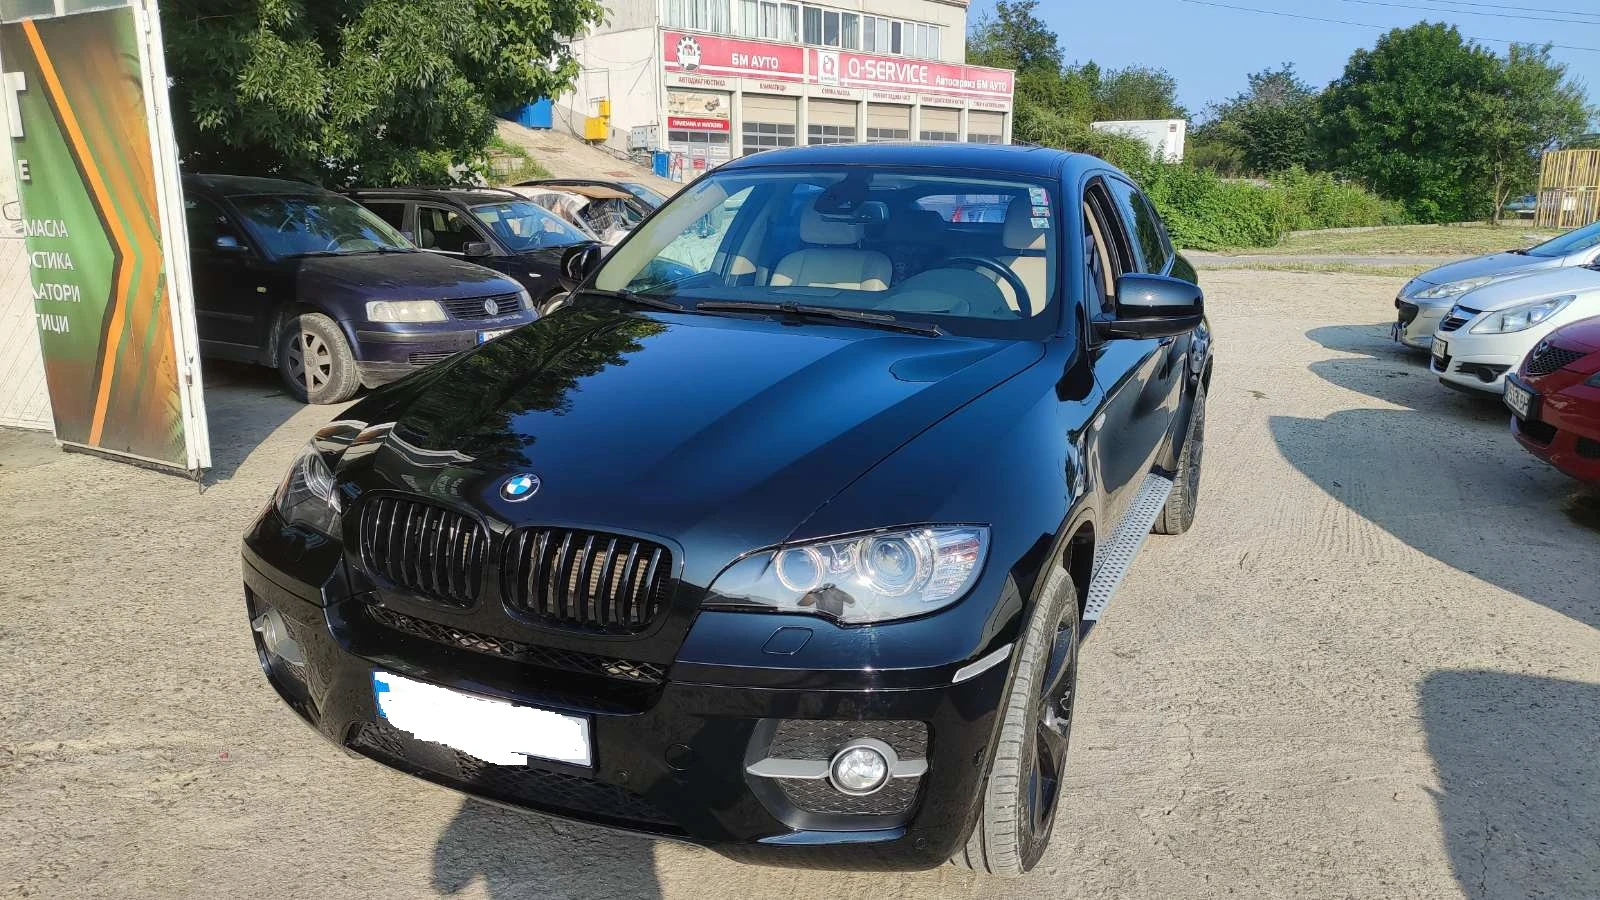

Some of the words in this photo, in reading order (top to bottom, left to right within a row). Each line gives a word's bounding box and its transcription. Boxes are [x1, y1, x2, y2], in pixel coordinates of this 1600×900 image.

[731, 52, 749, 66] БМ
[751, 55, 779, 70] АУТО
[848, 57, 929, 83] Q-SERVICE
[23, 219, 68, 238] МАСЛА
